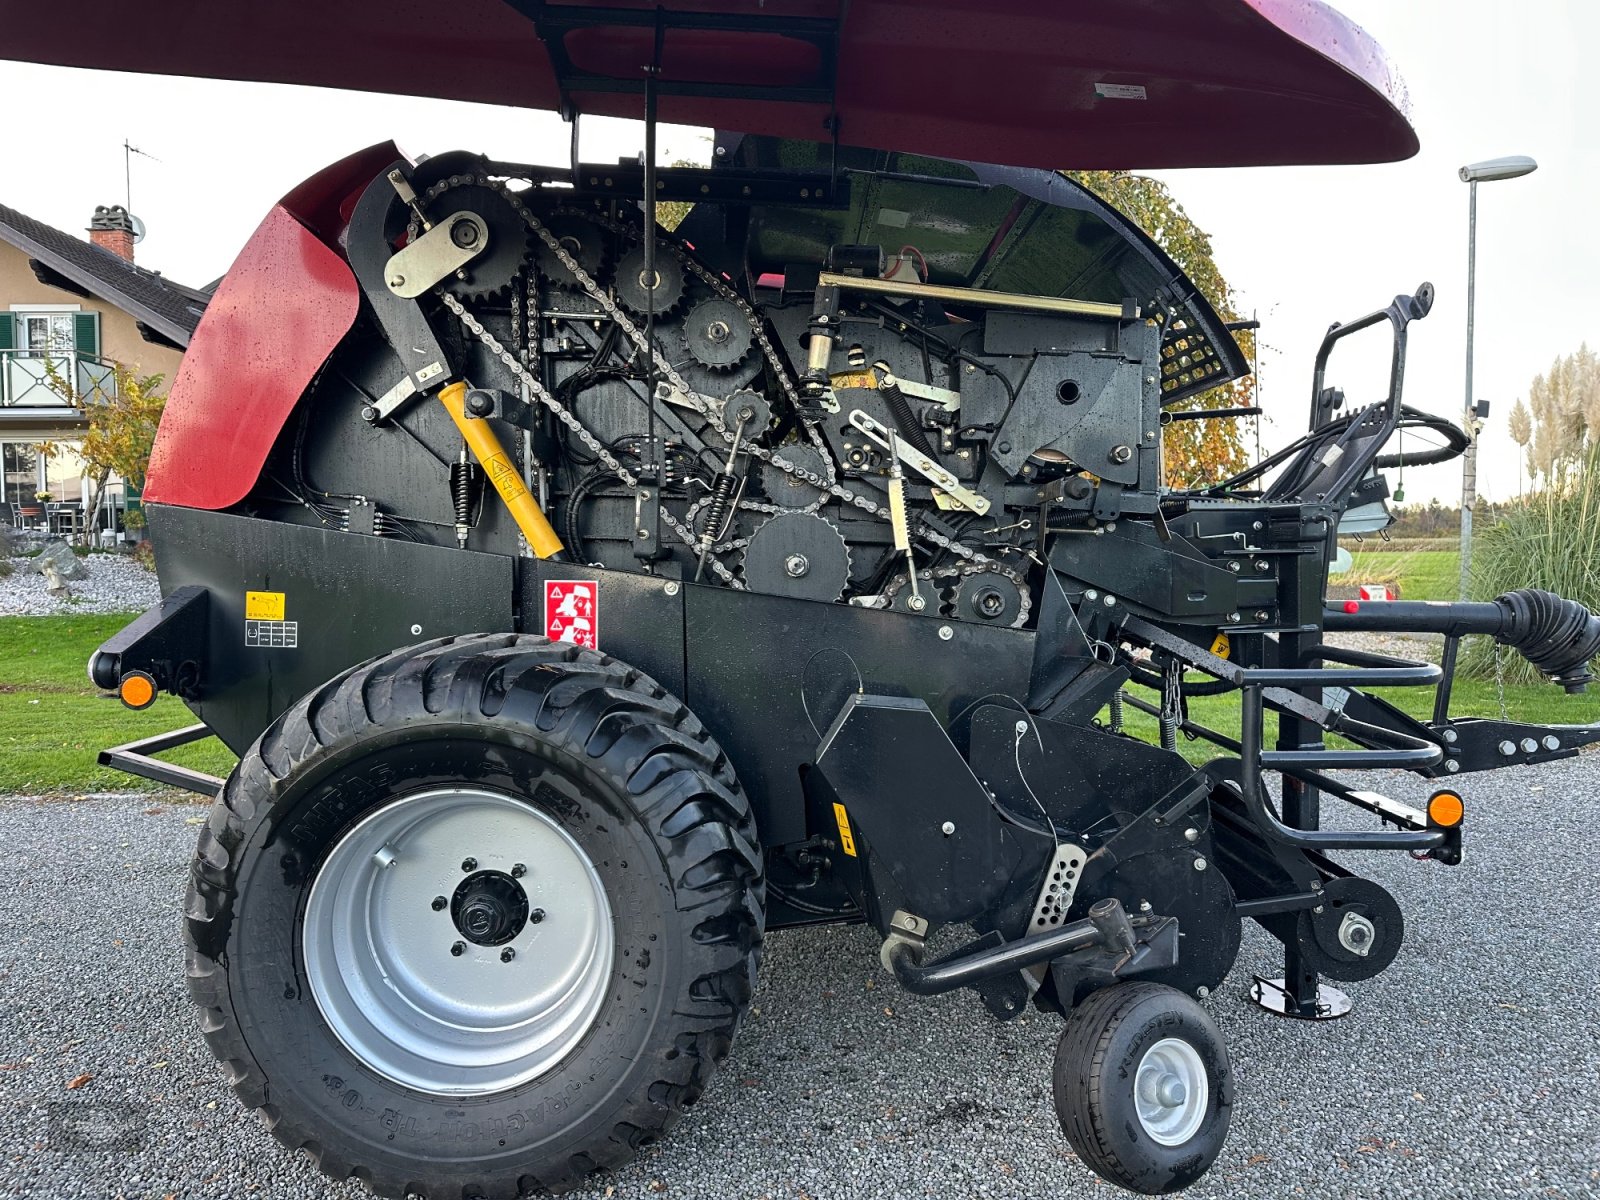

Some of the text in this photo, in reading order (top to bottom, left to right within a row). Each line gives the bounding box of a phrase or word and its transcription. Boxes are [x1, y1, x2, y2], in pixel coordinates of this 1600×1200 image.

[291, 763, 394, 841] MITAS
[324, 1075, 586, 1142] TRACTION TR-08
